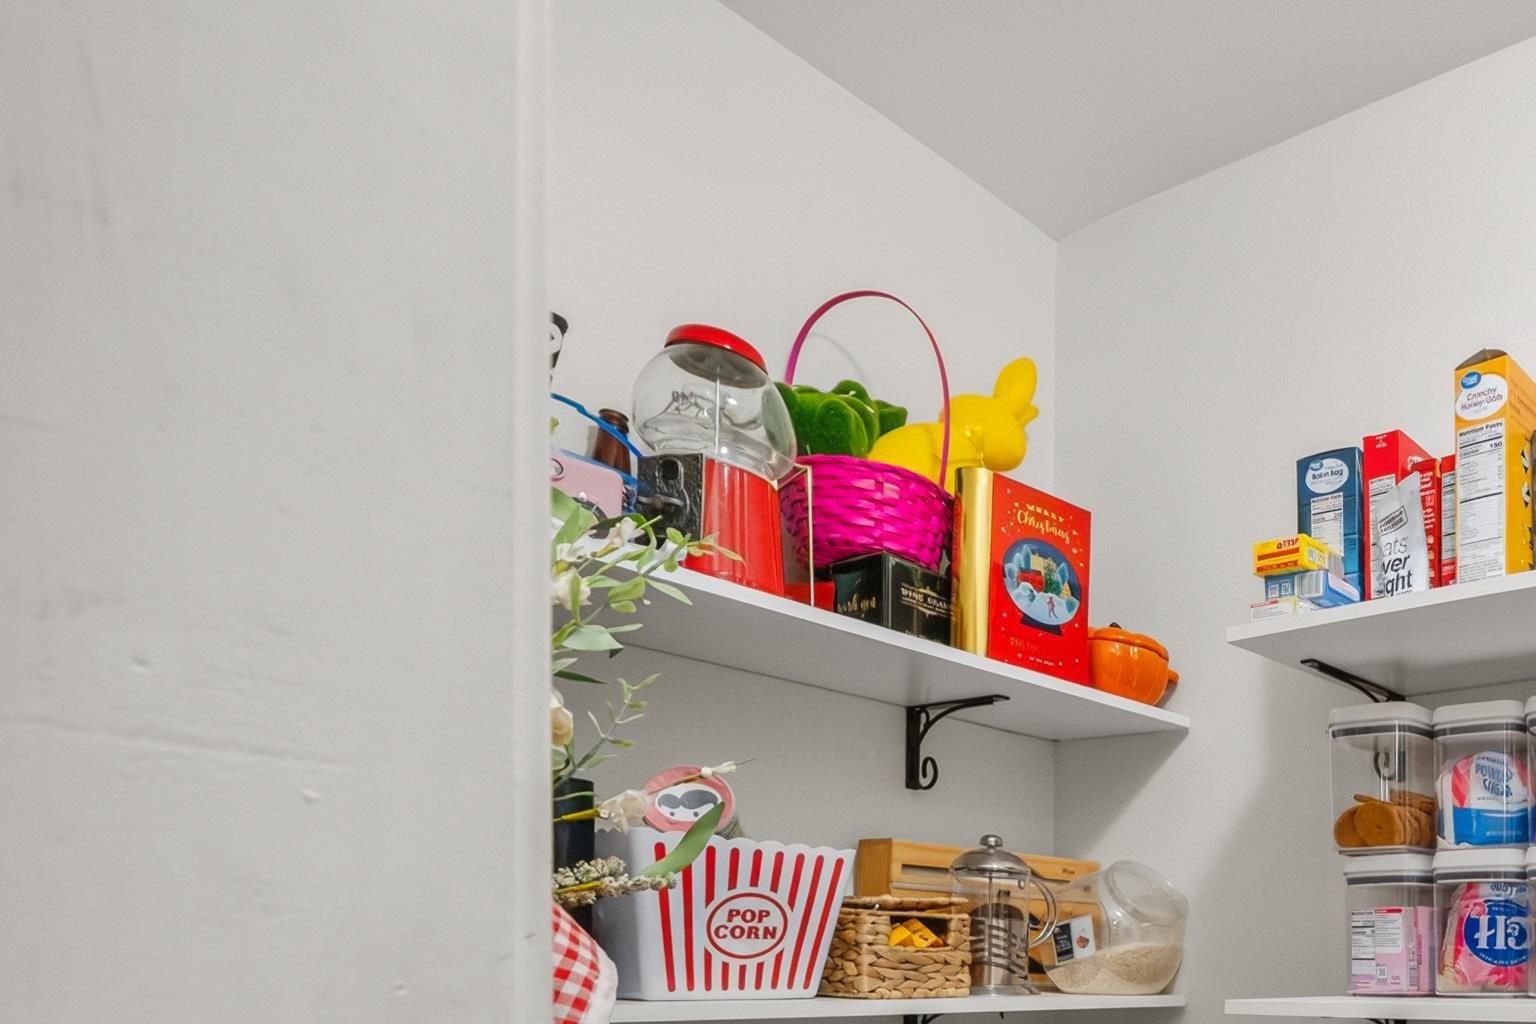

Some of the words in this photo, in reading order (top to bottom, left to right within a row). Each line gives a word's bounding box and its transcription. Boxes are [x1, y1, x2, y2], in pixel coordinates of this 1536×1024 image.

[1330, 468, 1344, 479] Bag
[1382, 536, 1408, 557] ats
[1381, 554, 1410, 574] ver
[901, 587, 924, 602] WINE
[726, 909, 771, 923] POP
[714, 925, 777, 939] CORN
